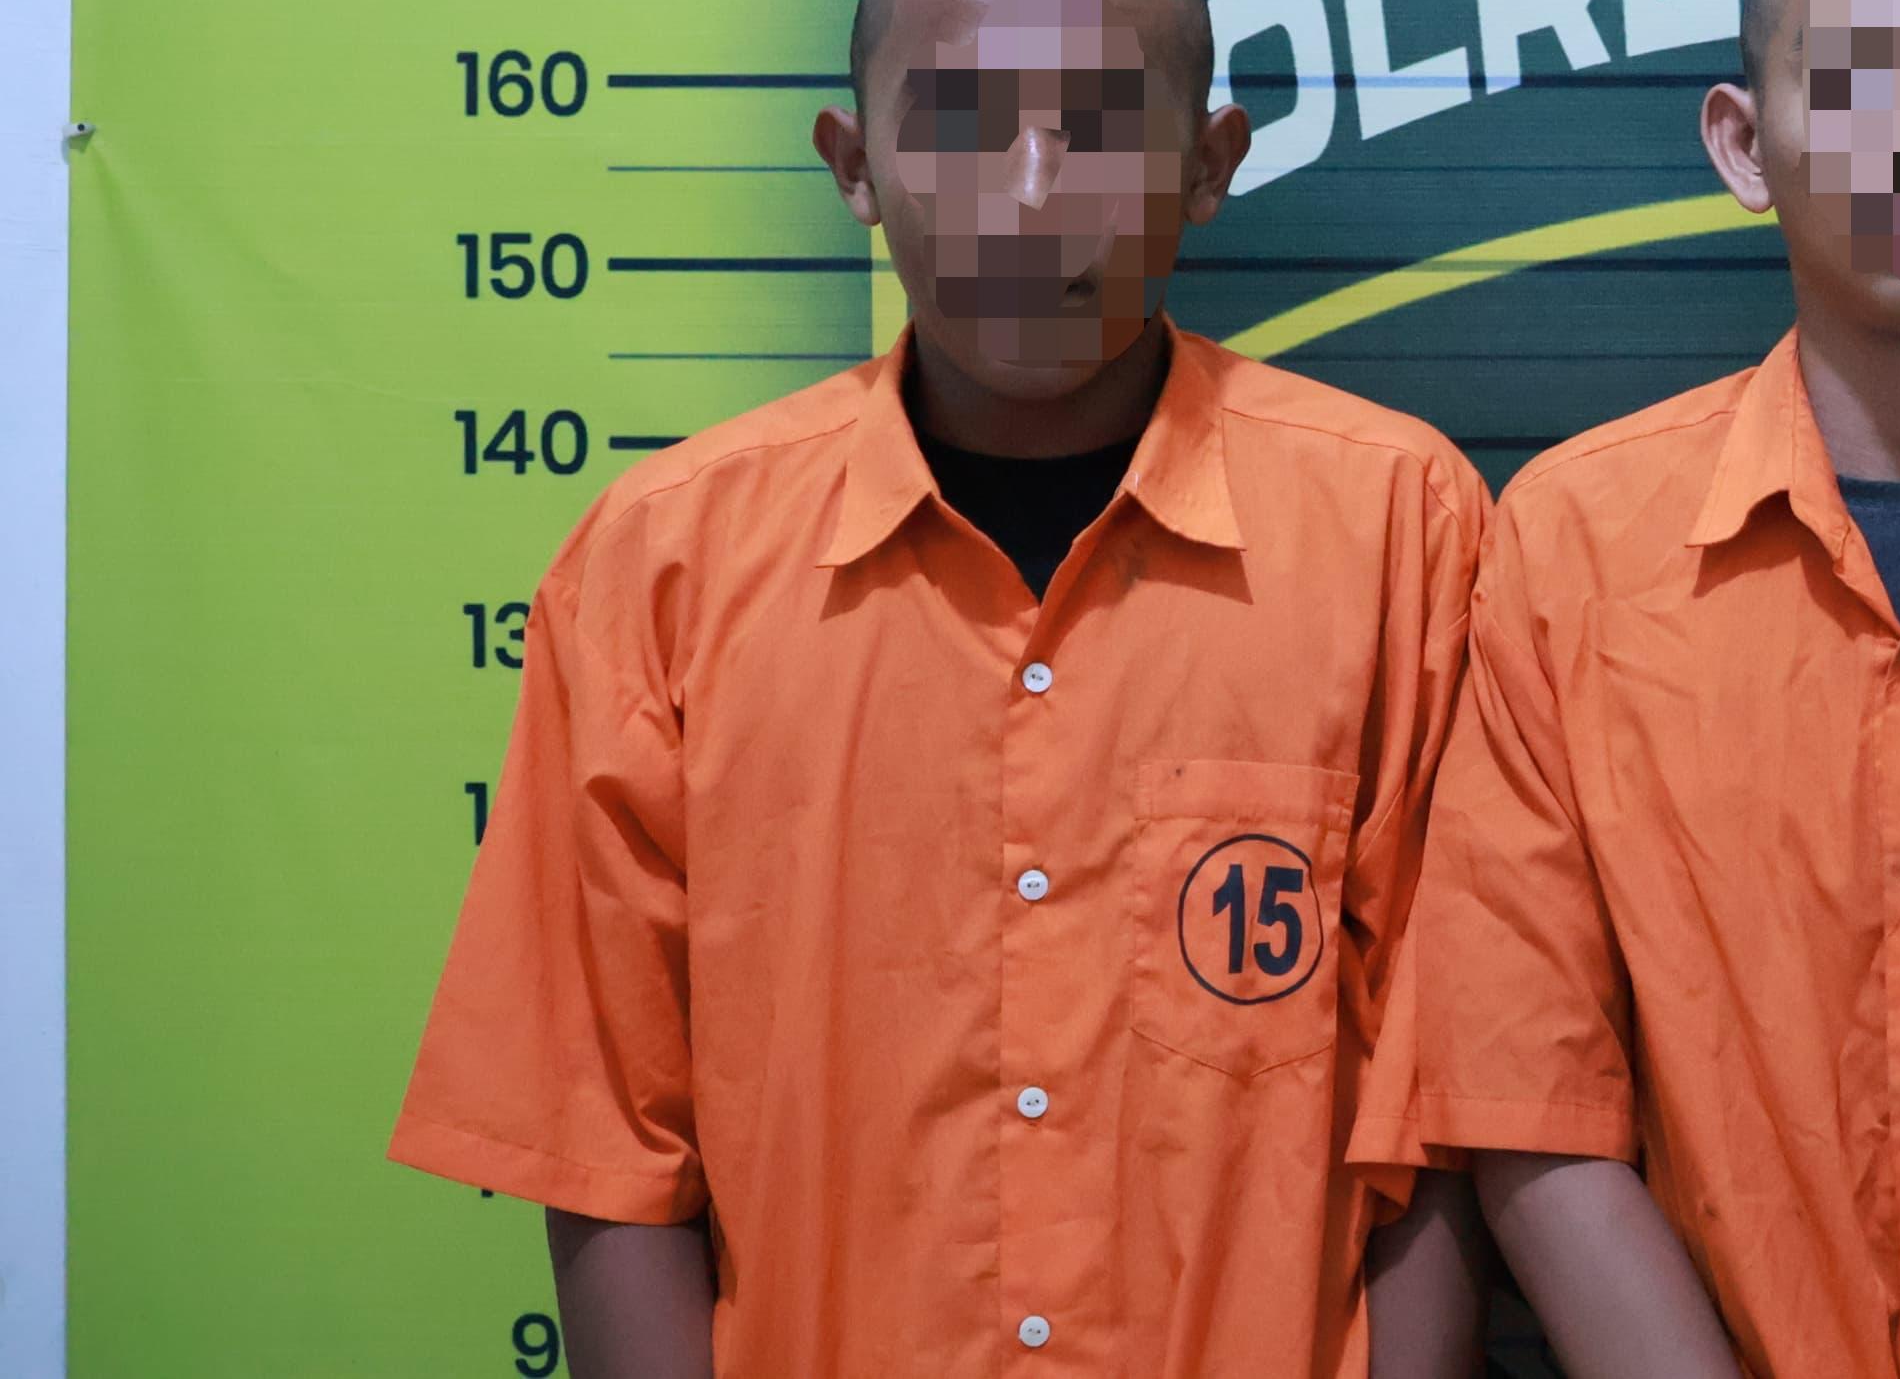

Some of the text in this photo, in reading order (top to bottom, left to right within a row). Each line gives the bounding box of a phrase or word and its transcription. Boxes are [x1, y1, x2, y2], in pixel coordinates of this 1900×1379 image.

[456, 50, 588, 117] 160
[456, 233, 588, 299] 150
[455, 410, 588, 475] 140
[463, 602, 531, 669] 13
[1212, 863, 1304, 977] 15
[512, 1313, 560, 1379] 9
